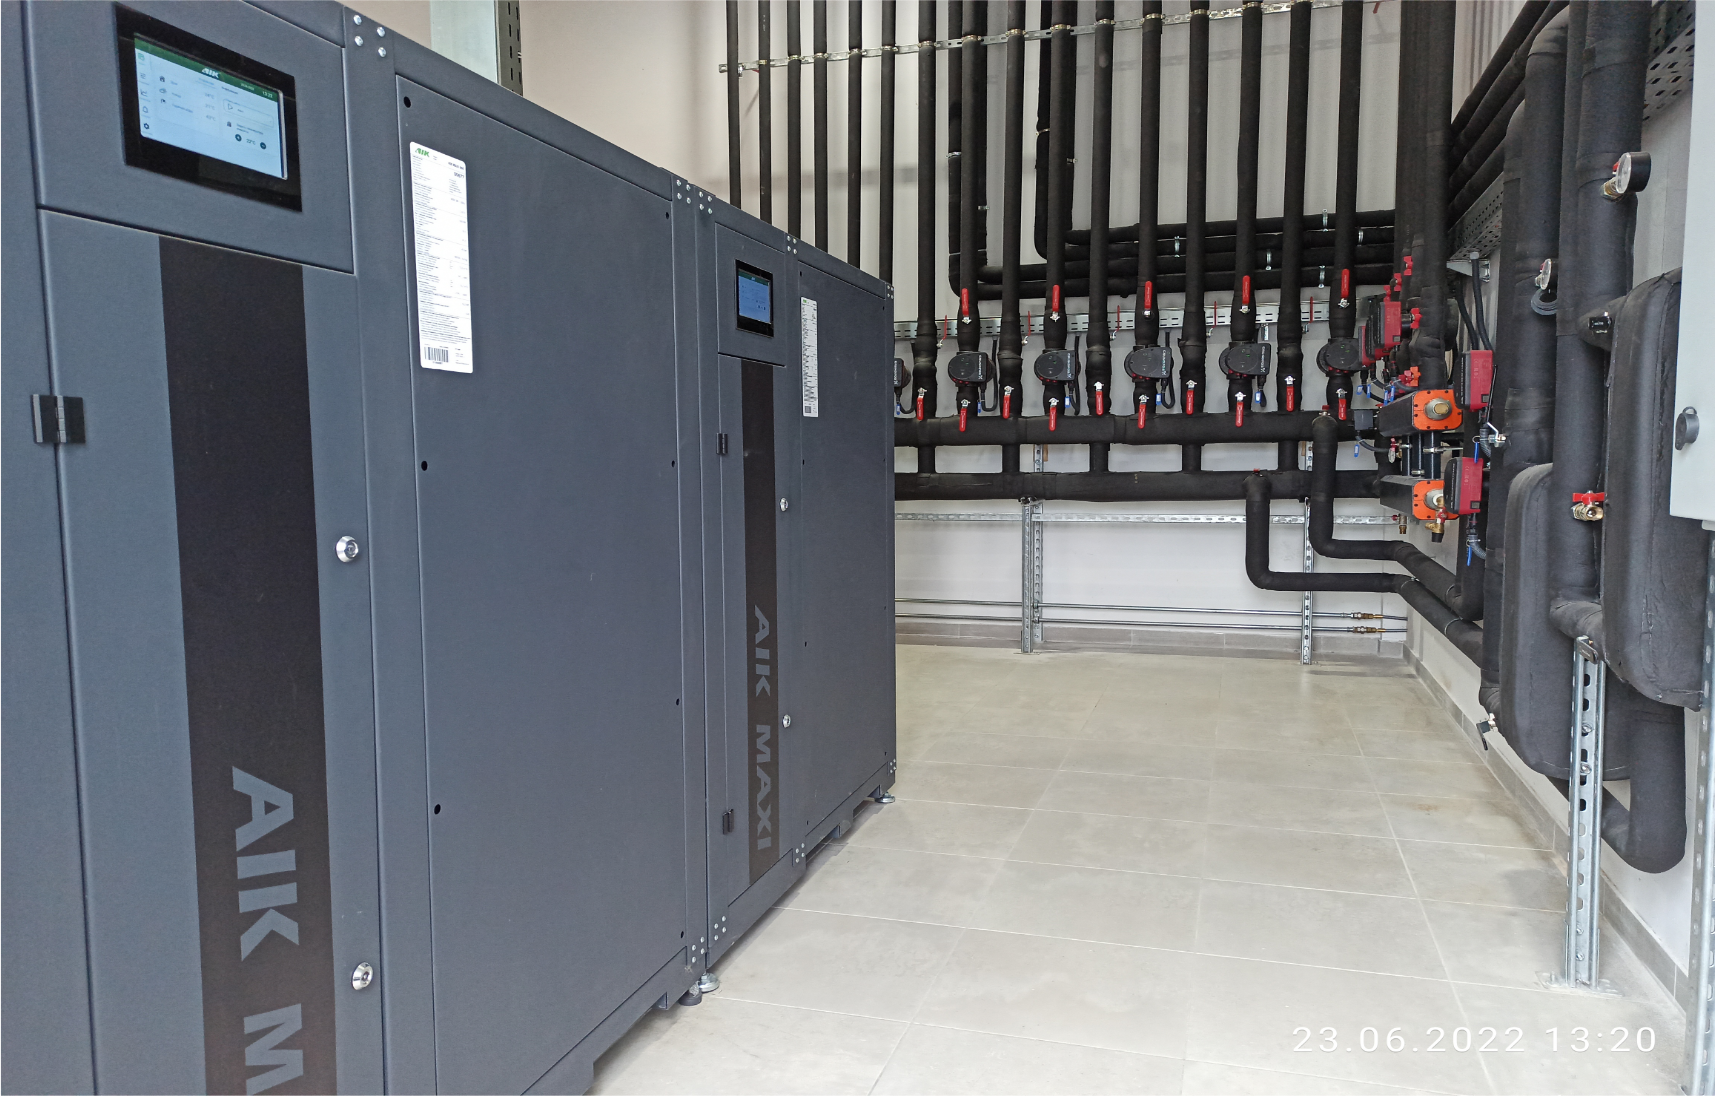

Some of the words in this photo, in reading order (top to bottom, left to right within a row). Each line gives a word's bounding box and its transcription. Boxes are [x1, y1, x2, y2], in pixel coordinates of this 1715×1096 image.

[201, 67, 219, 79] AIK
[414, 147, 430, 158] AIK
[754, 604, 771, 698] AIK
[755, 724, 772, 850] MAXI
[232, 765, 300, 962] AIK
